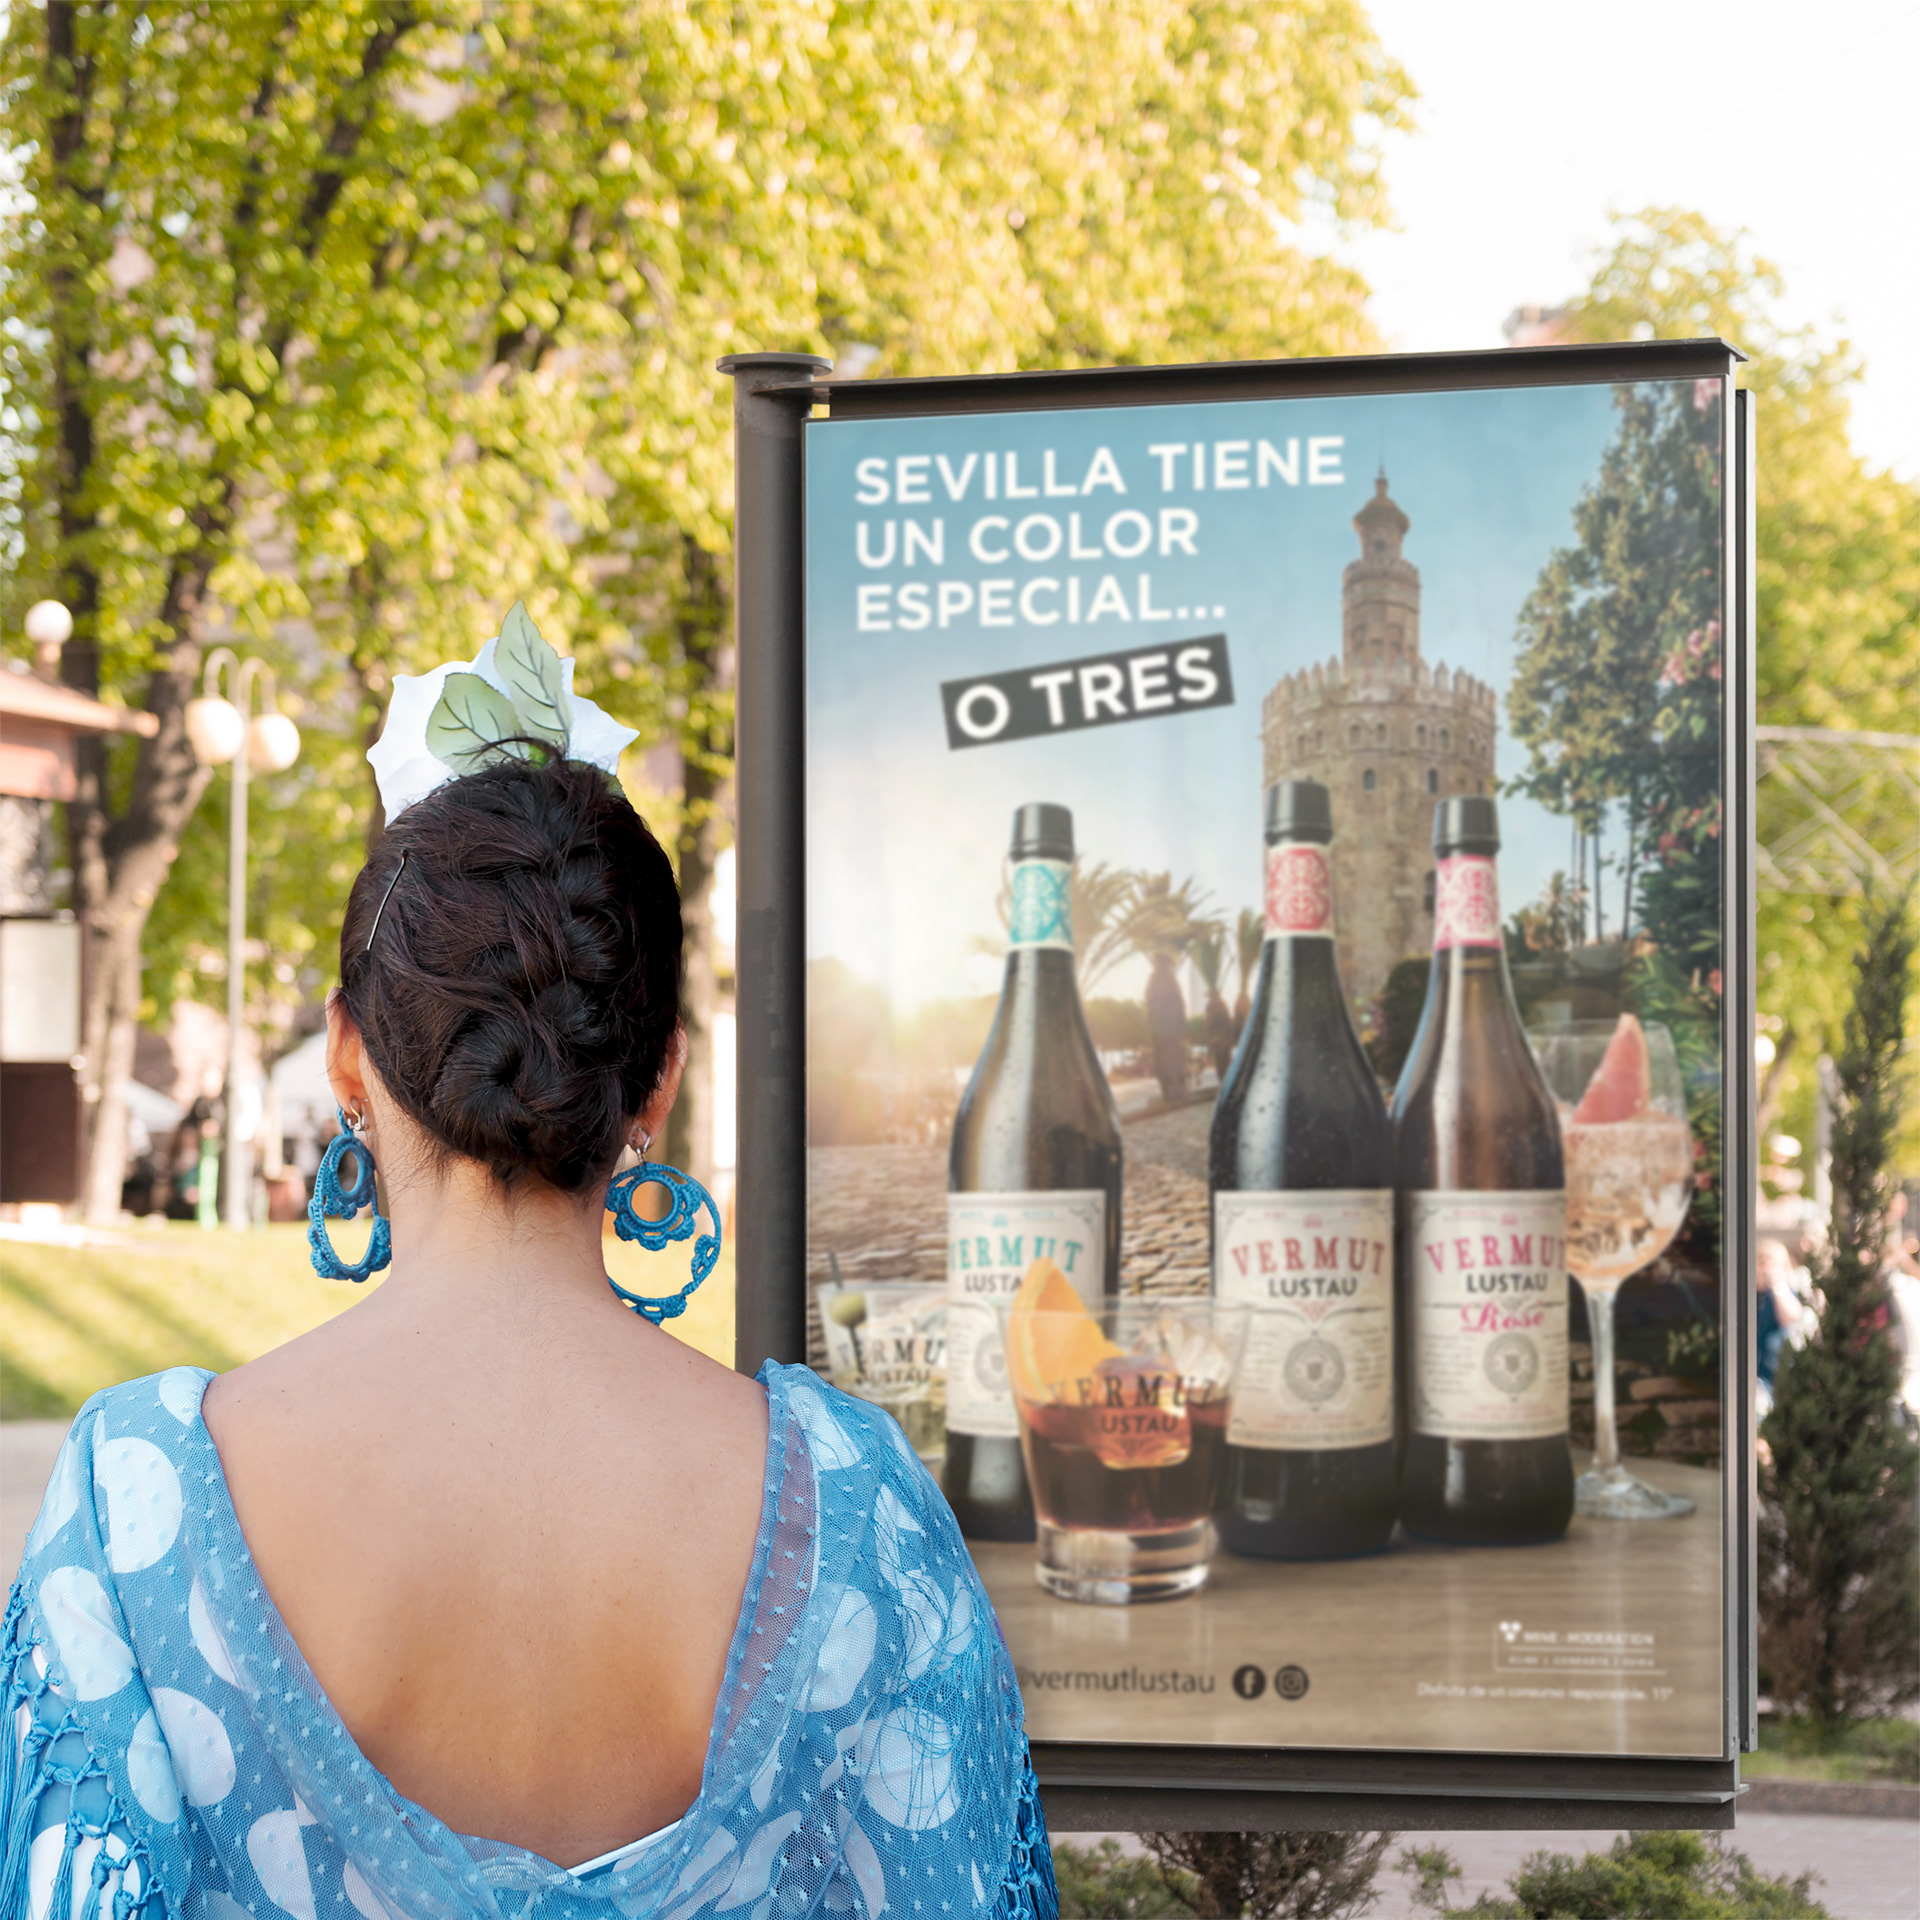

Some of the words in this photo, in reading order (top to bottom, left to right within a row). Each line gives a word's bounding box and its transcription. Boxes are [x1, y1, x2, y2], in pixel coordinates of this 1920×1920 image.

[855, 446, 1128, 505] SEVILLA
[1148, 435, 1345, 492] TIENE
[856, 518, 945, 568] UN
[968, 507, 1199, 564] COLOR
[856, 574, 1226, 632] ESPECIAL...
[955, 684, 1010, 739] O
[1030, 646, 1219, 726] TRES
[1230, 1235, 1386, 1278] VERMUT
[965, 1273, 1023, 1293] LUSTA
[1267, 1277, 1359, 1298] LUSTAU
[1465, 1273, 1549, 1294] LUSTAU
